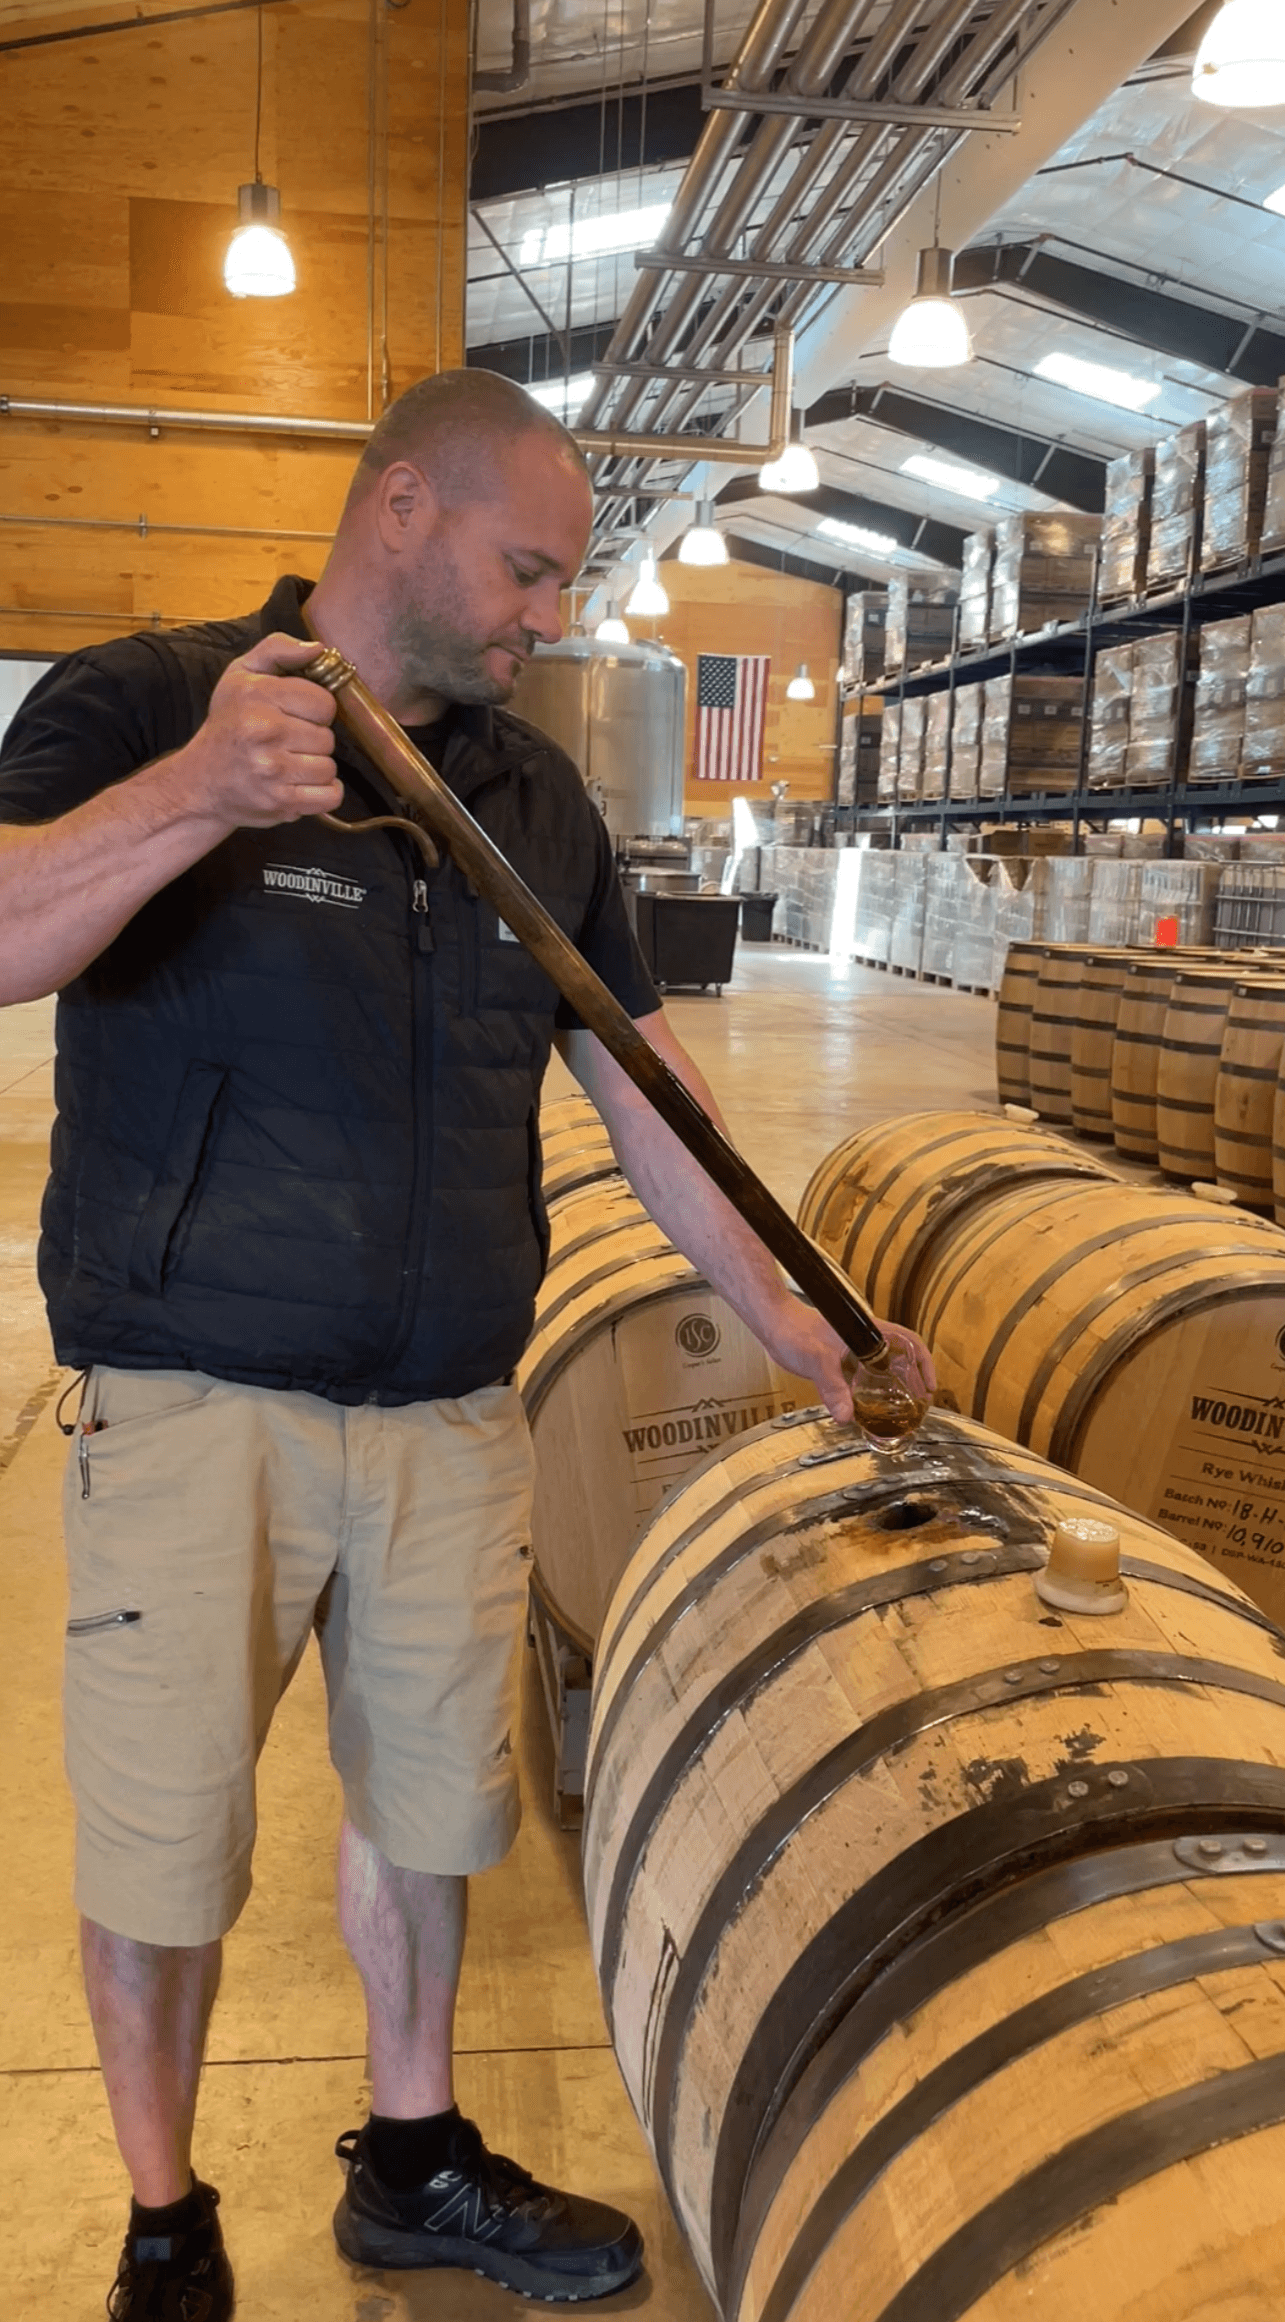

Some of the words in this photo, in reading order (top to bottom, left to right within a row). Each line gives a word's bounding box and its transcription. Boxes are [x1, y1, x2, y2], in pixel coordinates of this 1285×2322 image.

[263, 869, 363, 902] WOODINVILLE
[1203, 1462, 1234, 1479] Rye
[1164, 1488, 1203, 1506] Batch
[1158, 1508, 1200, 1526] Barrel
